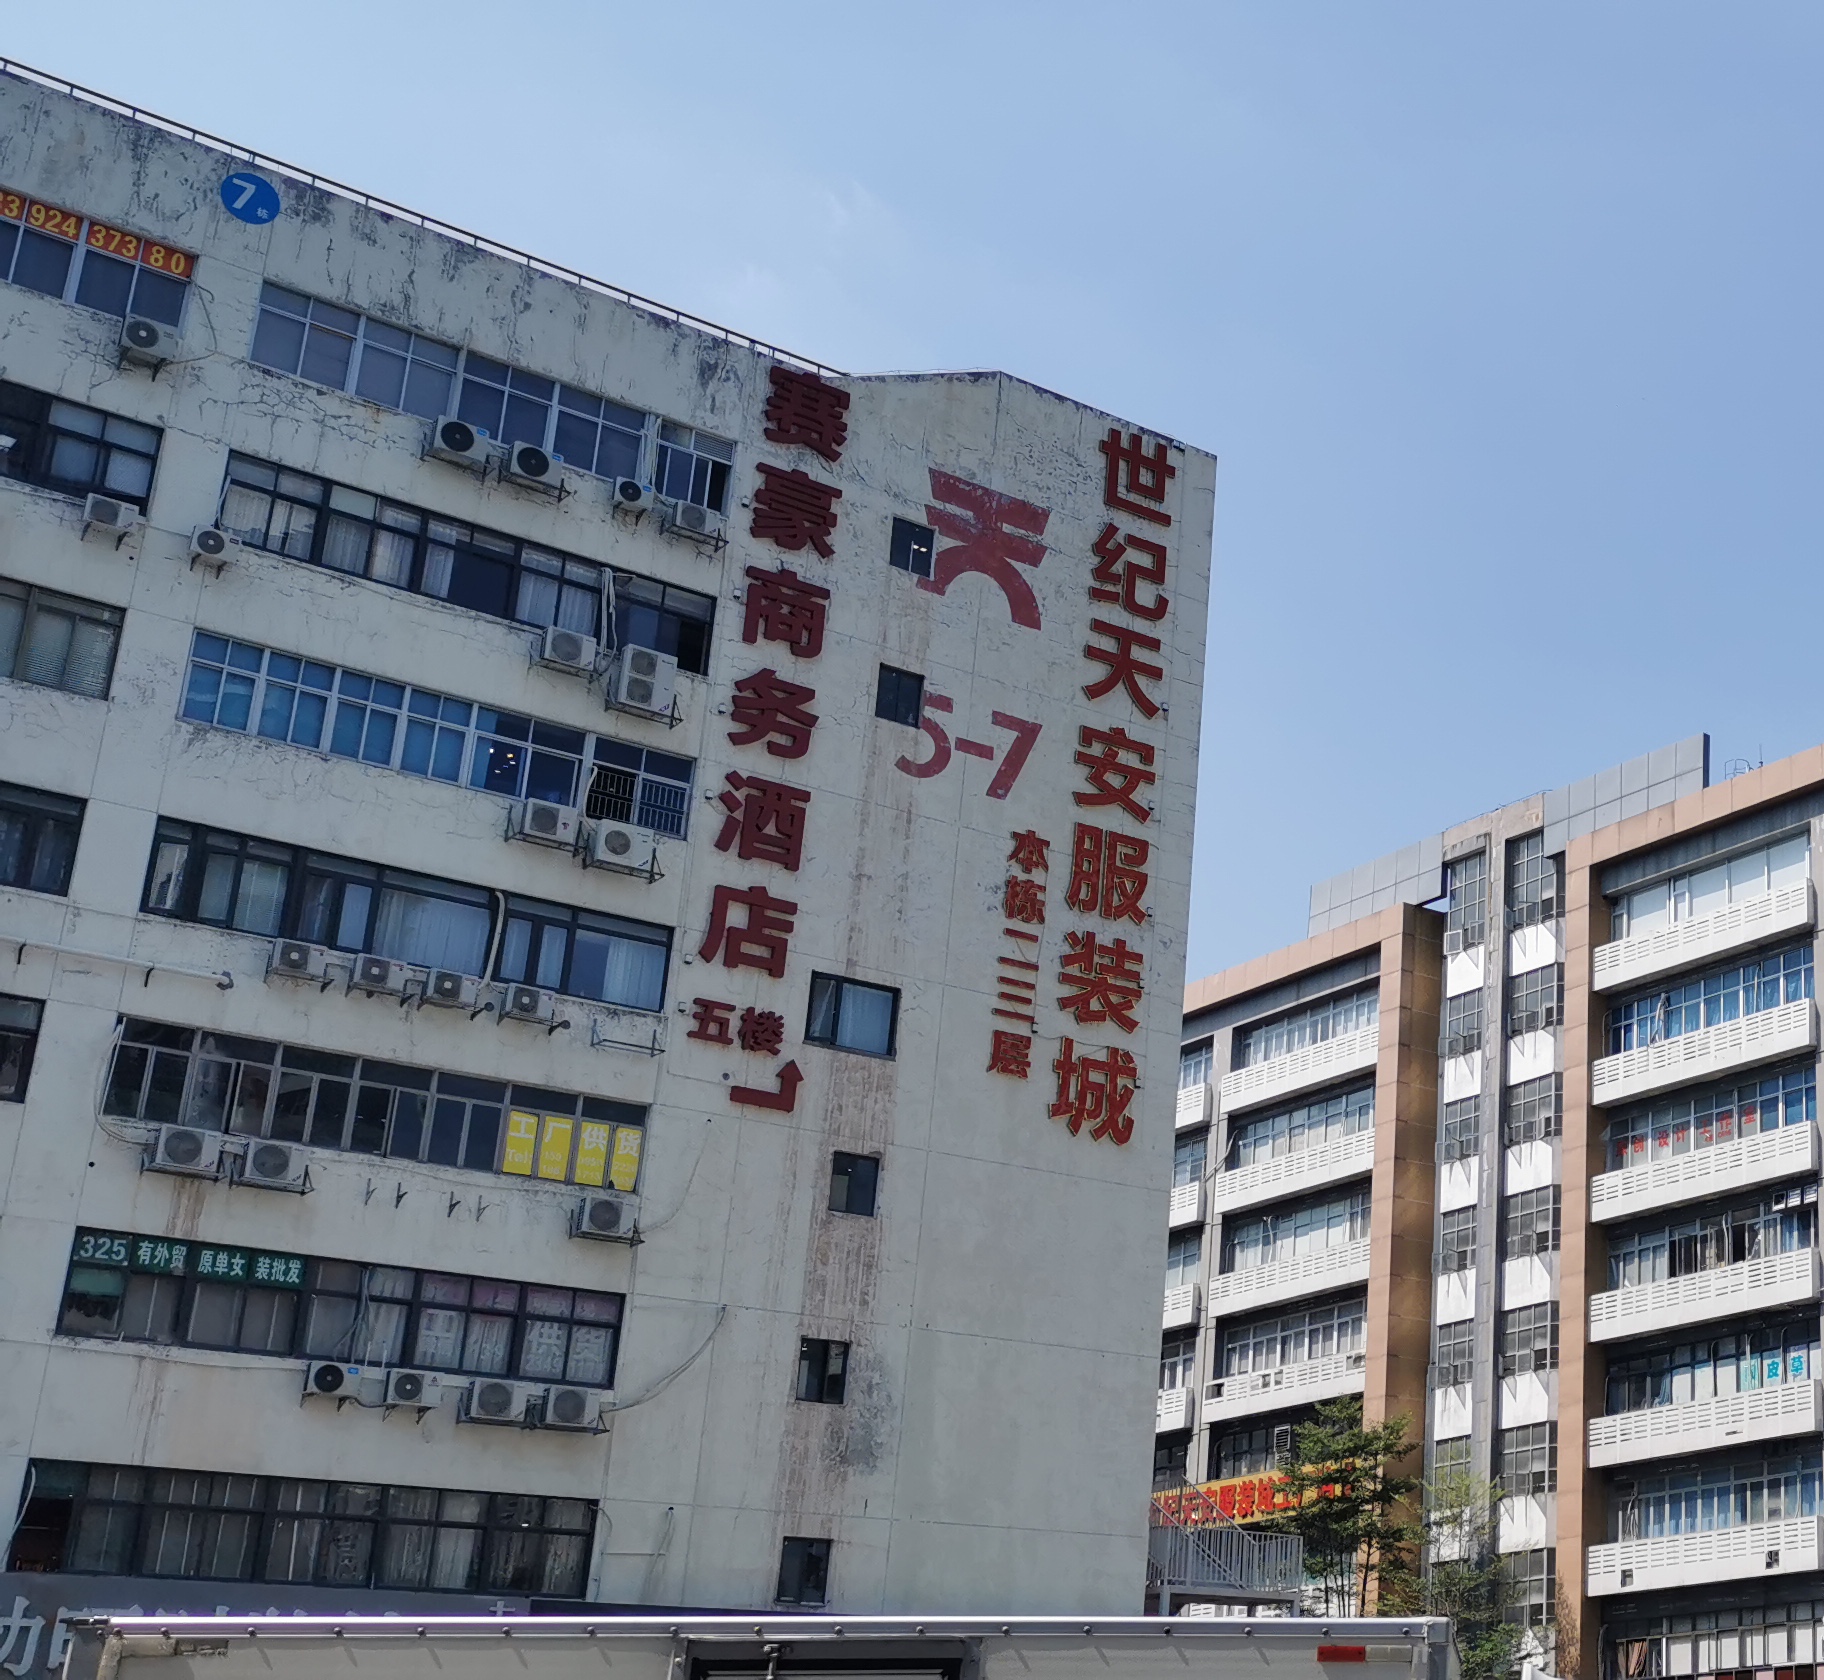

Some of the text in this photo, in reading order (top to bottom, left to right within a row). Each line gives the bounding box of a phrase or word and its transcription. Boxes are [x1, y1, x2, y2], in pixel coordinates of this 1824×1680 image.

[232, 177, 269, 220] 7栋
[30, 204, 78, 238] 924
[90, 225, 138, 258] 373
[150, 245, 186, 274] 80
[699, 365, 851, 978] 赛豪商务酒店
[894, 689, 1043, 801] 5-7
[1048, 427, 1176, 1146] 世纪天安服装城
[987, 829, 1051, 1079] 本栋二三层
[687, 997, 785, 1056] 五楼
[508, 1115, 641, 1157] 工厂供货
[80, 1235, 302, 1283] 325 有外贸原单女装批发
